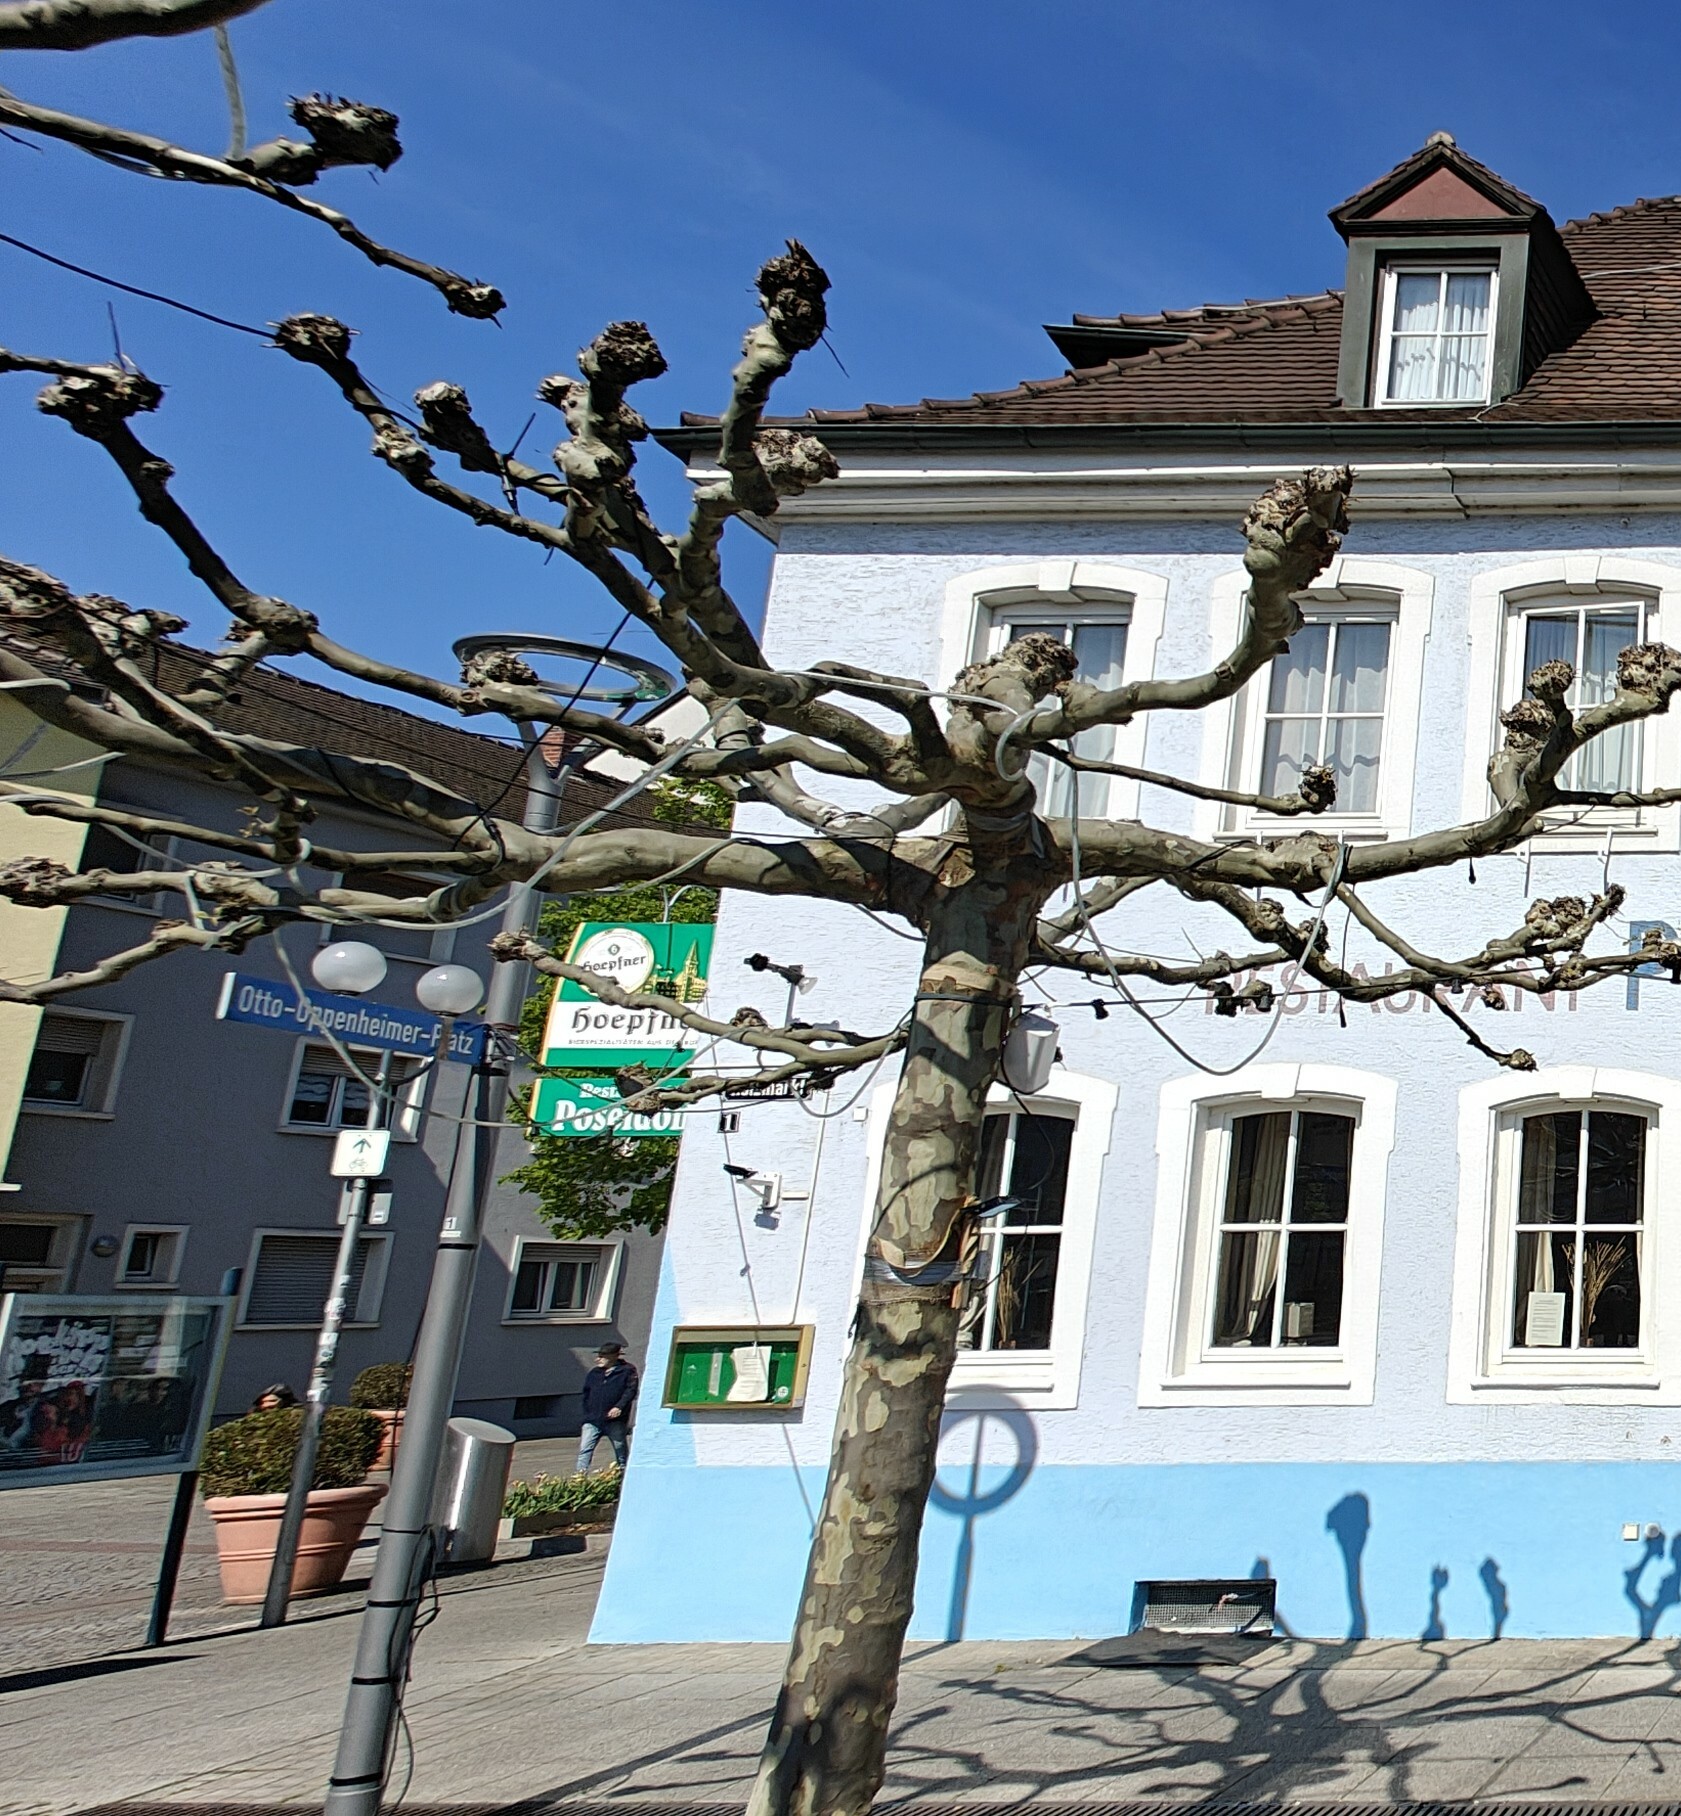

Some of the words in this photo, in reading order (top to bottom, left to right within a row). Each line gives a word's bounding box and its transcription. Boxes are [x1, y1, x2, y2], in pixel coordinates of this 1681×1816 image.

[237, 984, 475, 1056] Otto-Oppenheimer-Patz
[571, 1005, 689, 1036] Hoepfn
[724, 1113, 732, 1131] 1
